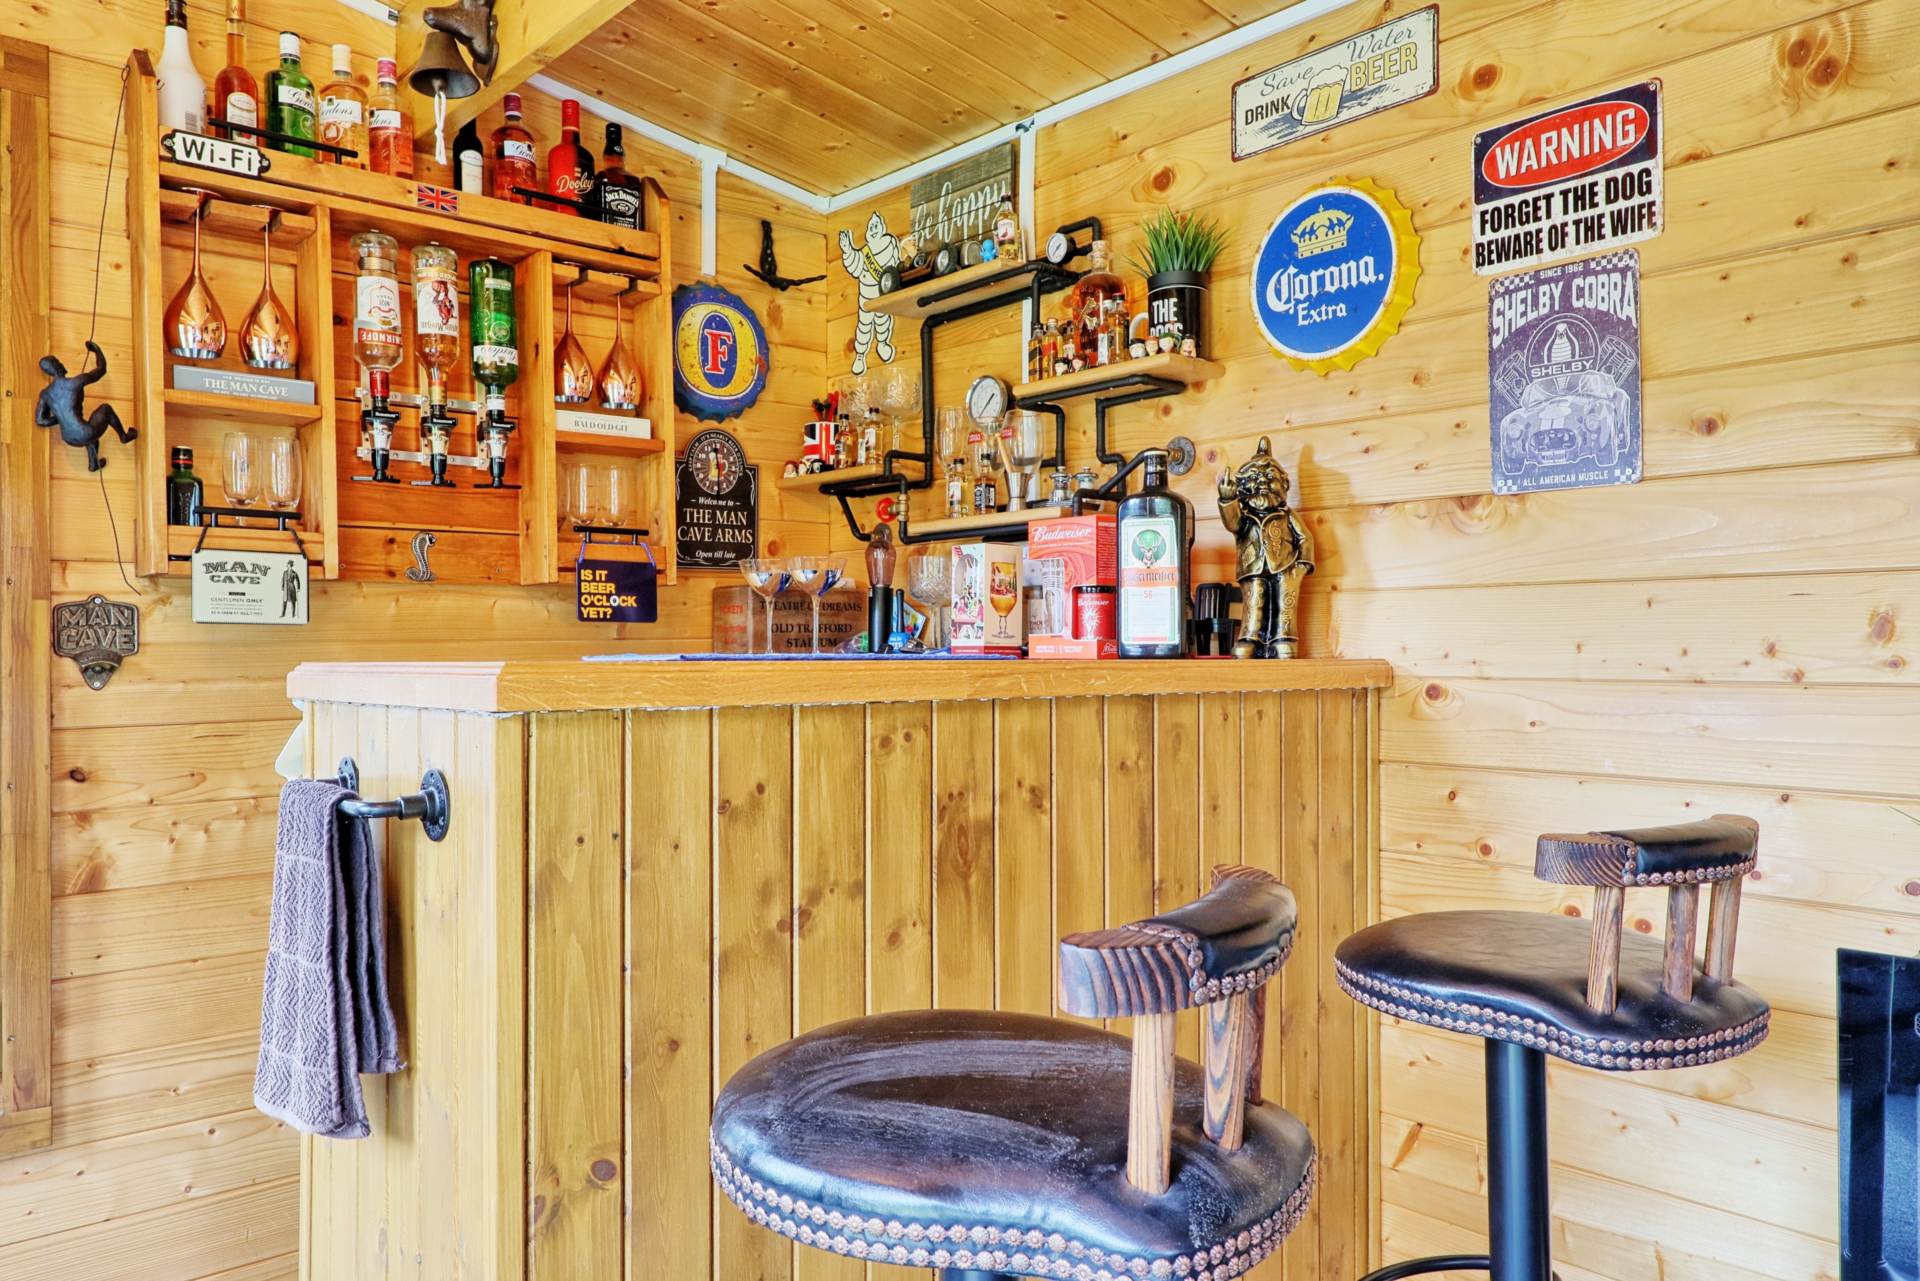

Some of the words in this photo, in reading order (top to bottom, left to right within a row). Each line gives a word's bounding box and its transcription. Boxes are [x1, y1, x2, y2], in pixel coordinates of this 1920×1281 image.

[1260, 65, 1315, 97] Save
[1346, 26, 1417, 62] Water
[1244, 94, 1292, 126] DRINK
[1349, 41, 1418, 93] BEER
[1495, 107, 1637, 180] WARNING
[182, 135, 254, 173] Wi-Fi
[1479, 191, 1555, 237] FORGET
[1559, 180, 1599, 217] THE
[1604, 167, 1653, 206] DOG
[1475, 227, 1544, 269] BEWARE
[1547, 221, 1570, 252] OF
[1572, 211, 1606, 246] THE
[1609, 199, 1657, 237] WIFE
[1539, 266, 1562, 280] SINCE
[1565, 262, 1584, 275] 1962
[1151, 297, 1179, 325] THE
[1296, 302, 1348, 327] Extra
[1492, 280, 1564, 350] SHELBY
[1571, 270, 1638, 329] COBRA
[703, 328, 733, 375] F
[1530, 359, 1594, 379] SHELBY
[202, 377, 229, 390] THE
[229, 381, 259, 394] MAN
[259, 385, 289, 397] CAVE
[574, 419, 596, 429] BALD
[596, 421, 614, 431] OLD
[614, 423, 629, 433] GIT
[1522, 479, 1537, 488] ALL
[1539, 473, 1576, 486] AMERICAN
[1579, 470, 1609, 482] MUSCLE
[727, 499, 734, 507] to
[683, 507, 713, 524] THE
[715, 509, 748, 526] MAN
[677, 525, 713, 542] CAVE
[715, 527, 753, 544] ARMS
[1031, 524, 1091, 543] Budweiser
[695, 549, 713, 560] Open
[713, 550, 723, 558] till
[723, 550, 737, 559] late
[202, 560, 271, 577] MAN
[580, 569, 593, 581] IS
[595, 570, 608, 581] IT
[209, 574, 261, 585] CAVE
[580, 582, 616, 594] BEER
[580, 594, 637, 607] O'CLOCK
[759, 600, 804, 611] TEATRE
[822, 602, 863, 613] DREAMS
[61, 605, 133, 627] MAN
[580, 606, 613, 619] YET?
[771, 623, 794, 634] OLD
[795, 623, 853, 634] TRFFORD
[59, 626, 135, 651] CAVE
